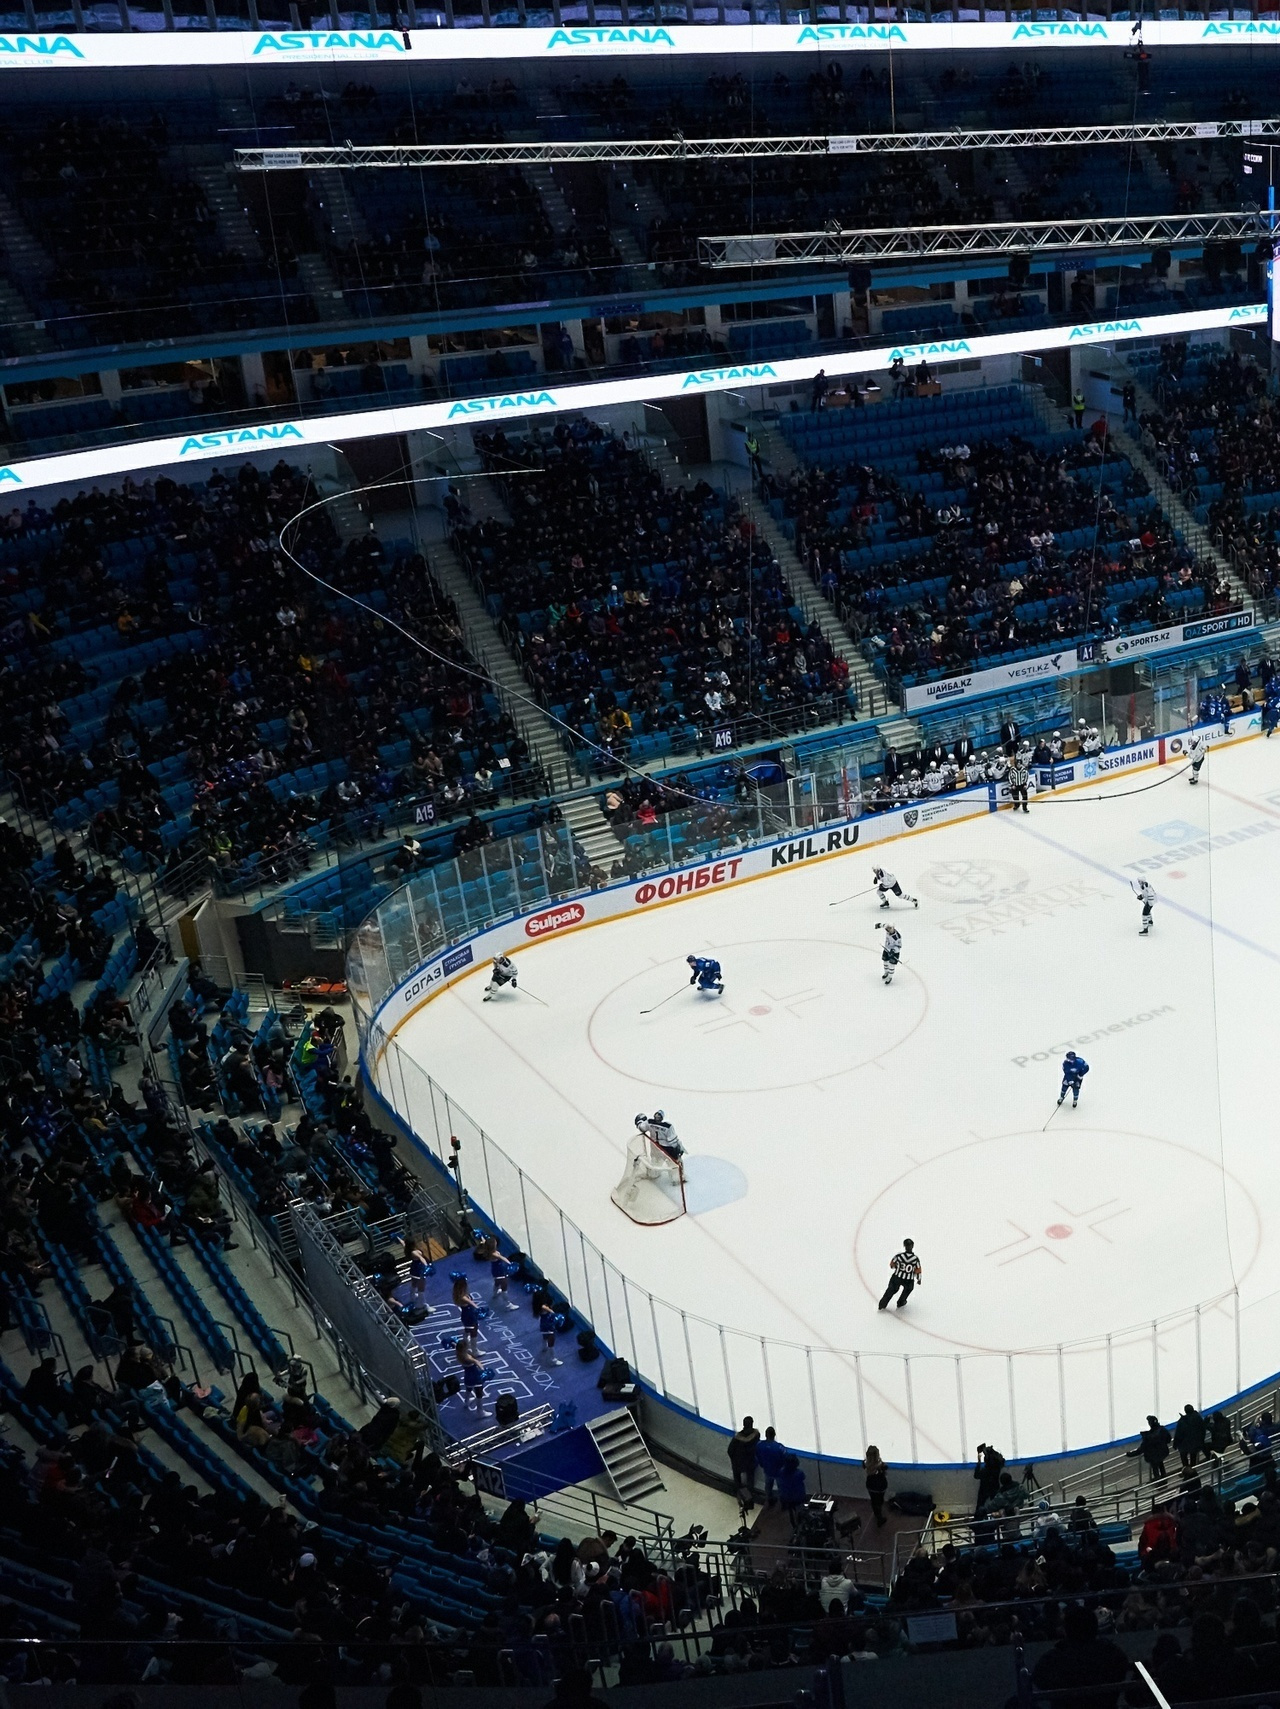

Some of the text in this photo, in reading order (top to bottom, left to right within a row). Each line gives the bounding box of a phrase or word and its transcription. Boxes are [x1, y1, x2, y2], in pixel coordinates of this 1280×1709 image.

[547, 27, 676, 48] ASTANA
[796, 25, 909, 44] ASTANA
[1012, 22, 1108, 39] ASTANA
[252, 32, 406, 55] ASTANA
[1069, 319, 1142, 341] ASTANA
[887, 339, 971, 363] ASTANA
[682, 364, 777, 389] ASTANA
[447, 392, 557, 419] ASTANA
[179, 424, 304, 455] ASTANA
[1237, 615, 1251, 626] HD
[1130, 632, 1170, 647] SPORTS.KZ
[1082, 646, 1093, 660] A1
[1008, 663, 1049, 678] VESTI.KZ
[927, 678, 972, 695] ШАЙБА.KZ
[715, 731, 732, 748] A16
[1104, 748, 1155, 770] SESNABANK
[416, 804, 434, 823] A15
[771, 825, 859, 867] KHL.RU
[635, 857, 743, 904] ФОНБЕТ
[528, 907, 582, 932] Sulpak
[939, 883, 1099, 936] SAMRUK
[404, 966, 442, 1002] СОГАЗ
[1015, 1006, 1174, 1070] Ростелеком
